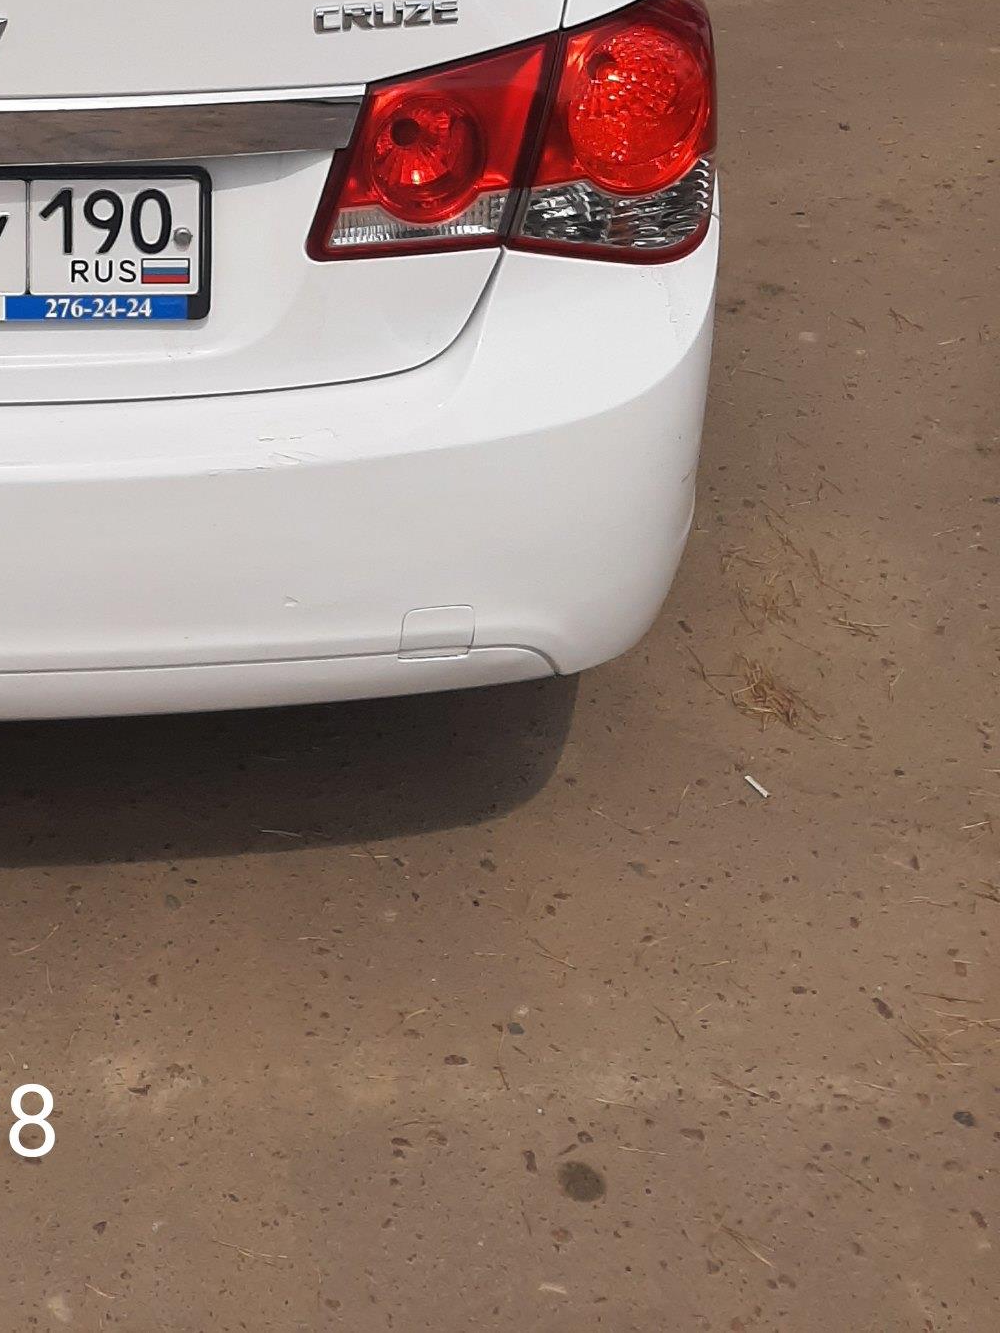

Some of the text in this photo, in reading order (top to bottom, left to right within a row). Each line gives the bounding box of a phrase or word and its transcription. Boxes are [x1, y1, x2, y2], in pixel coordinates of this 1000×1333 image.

[39, 187, 174, 255] 190
[70, 259, 138, 284] RUS
[44, 297, 153, 319] 276-24-24
